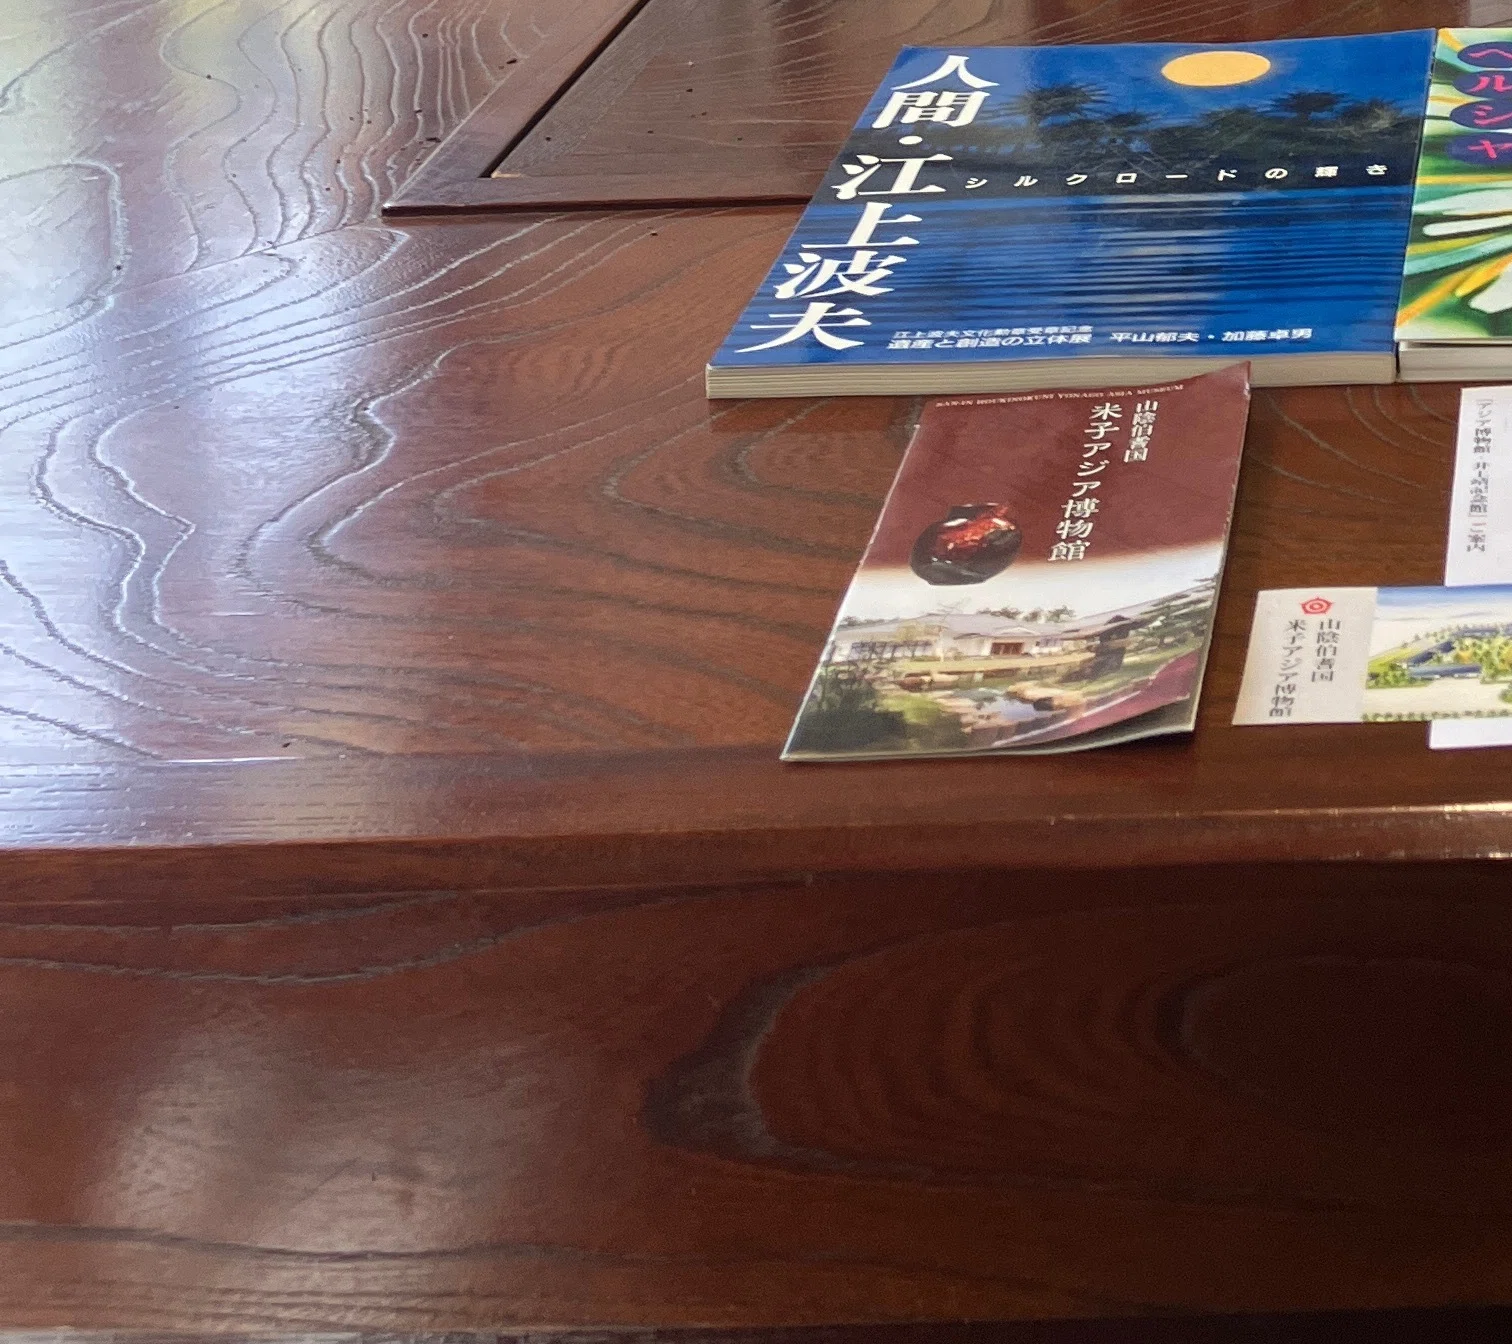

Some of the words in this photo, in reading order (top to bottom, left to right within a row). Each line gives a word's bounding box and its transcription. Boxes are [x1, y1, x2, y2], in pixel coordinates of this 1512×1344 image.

[739, 54, 999, 352] 人間・江上波夫
[965, 163, 1388, 190] シルクロードの輝き
[1109, 327, 1313, 343] 平山郁夫・加藤卓男
[1122, 400, 1159, 463] 山陰伯耆国
[1047, 401, 1123, 562] 米子アジア博物館
